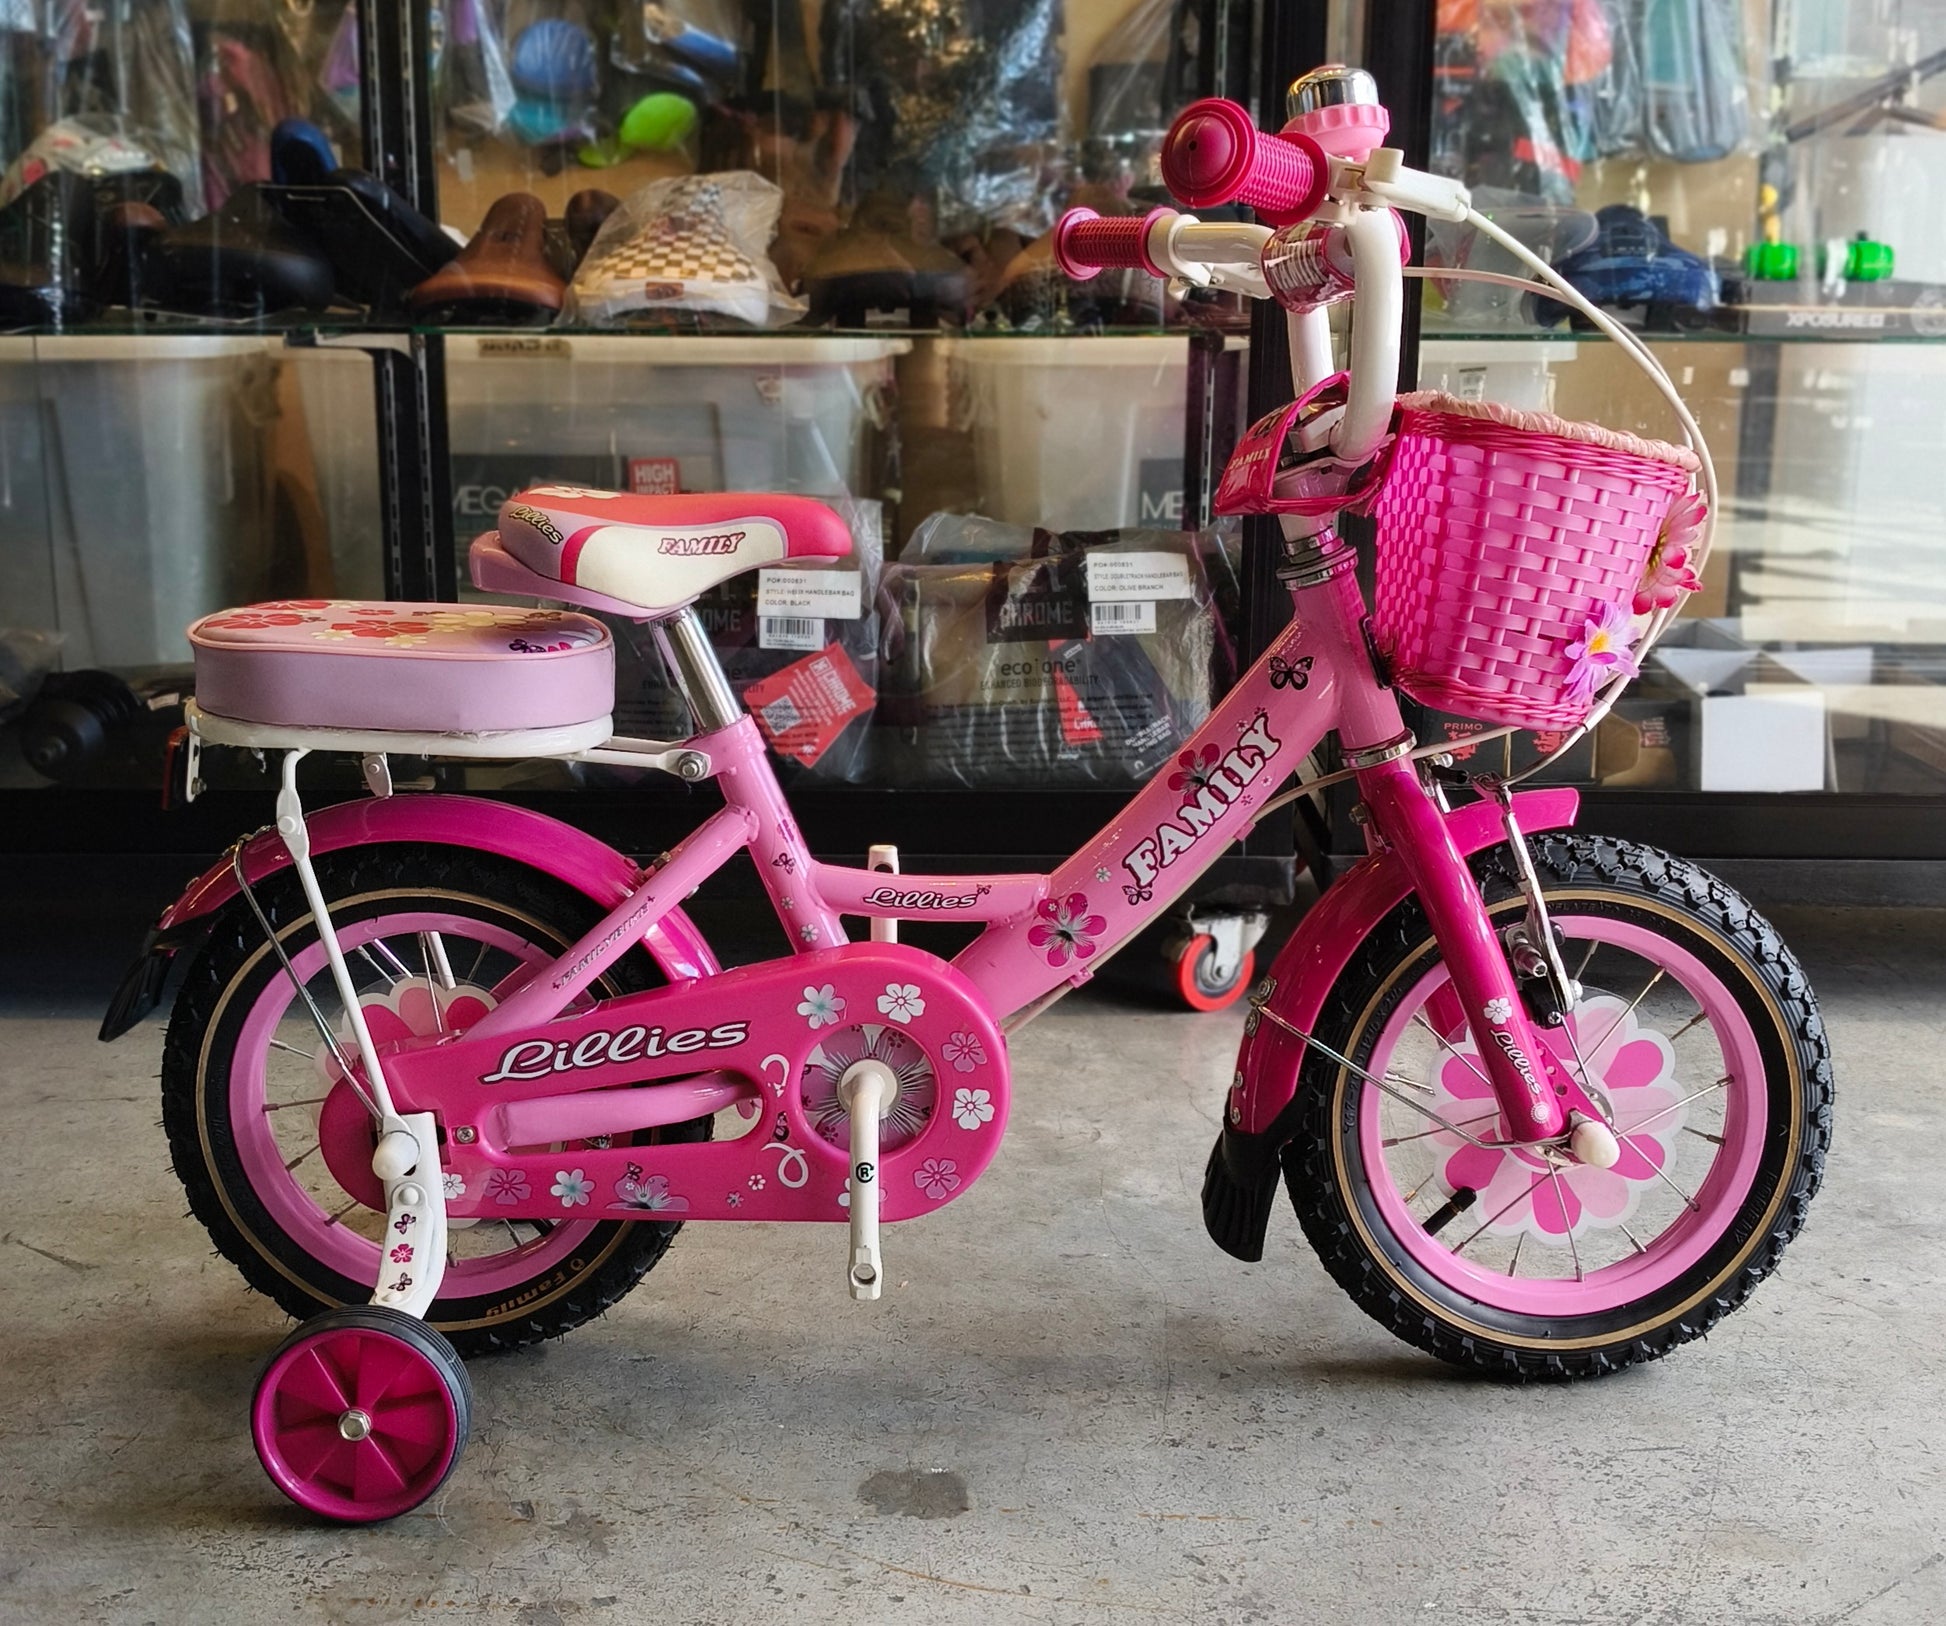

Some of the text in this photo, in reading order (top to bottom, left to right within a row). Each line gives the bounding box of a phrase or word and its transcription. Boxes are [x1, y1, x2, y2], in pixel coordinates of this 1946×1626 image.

[635, 463, 674, 483] HIGH
[1229, 447, 1272, 470] FAMILY
[508, 505, 564, 545] Lillies
[658, 532, 746, 556] FAMILY
[1119, 584, 1137, 592] OLIVE
[1138, 583, 1164, 591] BRANCH
[822, 668, 856, 714] CHROME
[1444, 722, 1482, 731] PRIMO
[1122, 712, 1282, 889] FAMILY
[864, 887, 978, 909] Lillies
[480, 1022, 750, 1084] Lillies
[1489, 1028, 1543, 1096] Lillies
[485, 1271, 567, 1317] Family
